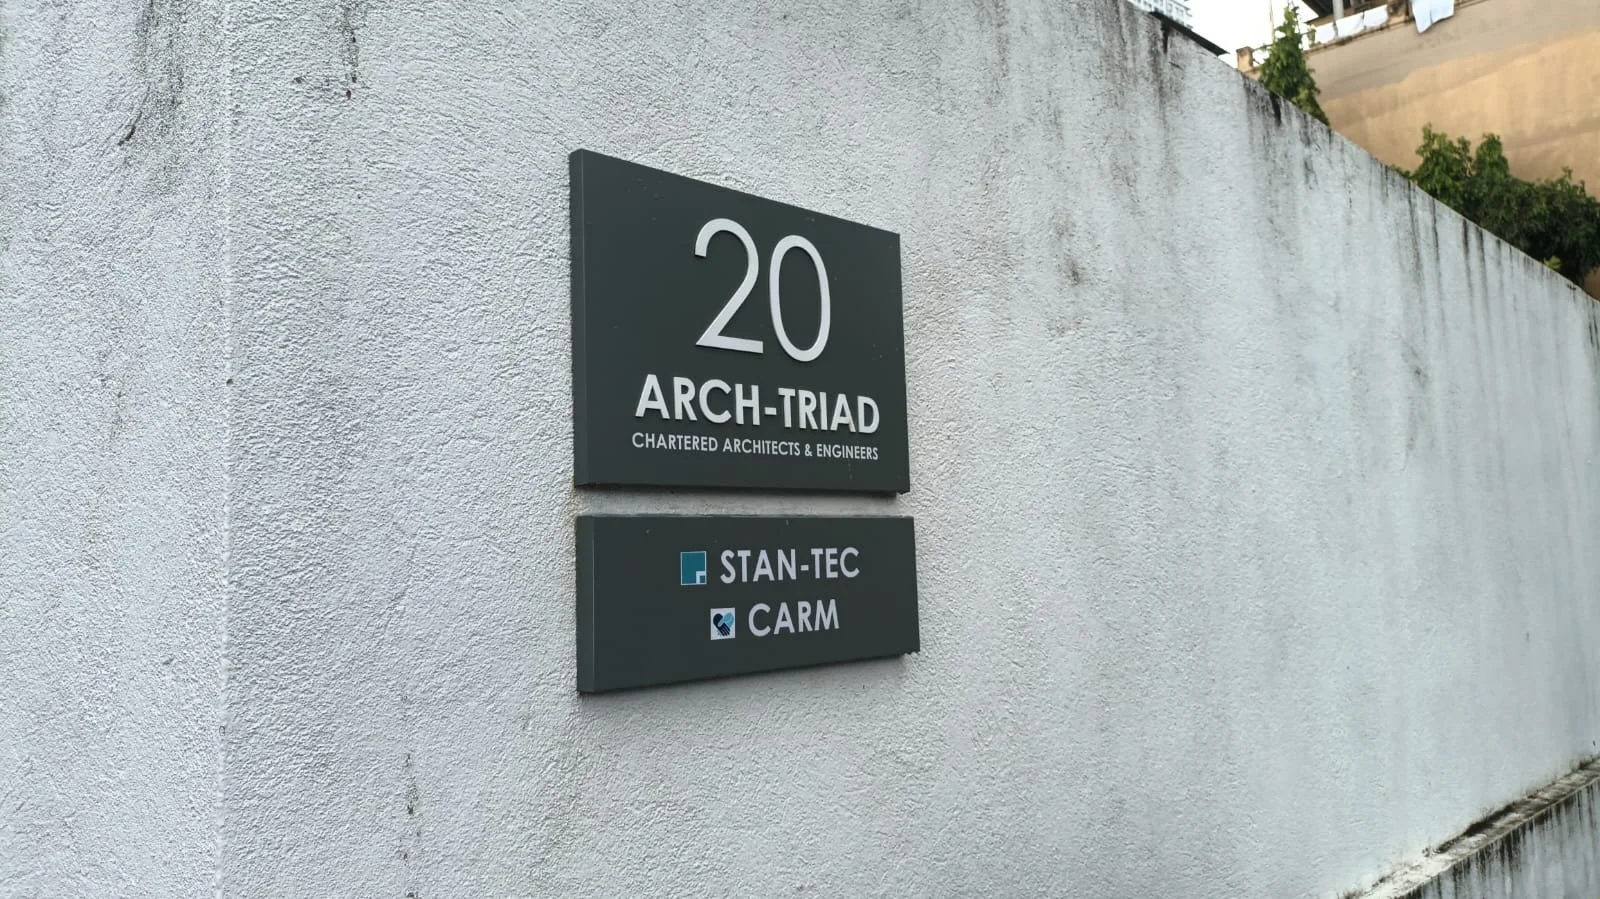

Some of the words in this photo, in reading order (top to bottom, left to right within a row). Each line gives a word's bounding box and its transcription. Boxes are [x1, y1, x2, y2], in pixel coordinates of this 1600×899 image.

[694, 217, 831, 362] 20
[635, 373, 880, 434] ARCH-TRIAD
[631, 432, 718, 452] CHARTERED
[722, 438, 801, 457] ARCHITECTS
[804, 443, 813, 457] &
[816, 444, 879, 460] ENGINEERS
[720, 546, 860, 584] STAN-TEC
[748, 598, 840, 637] CARM
